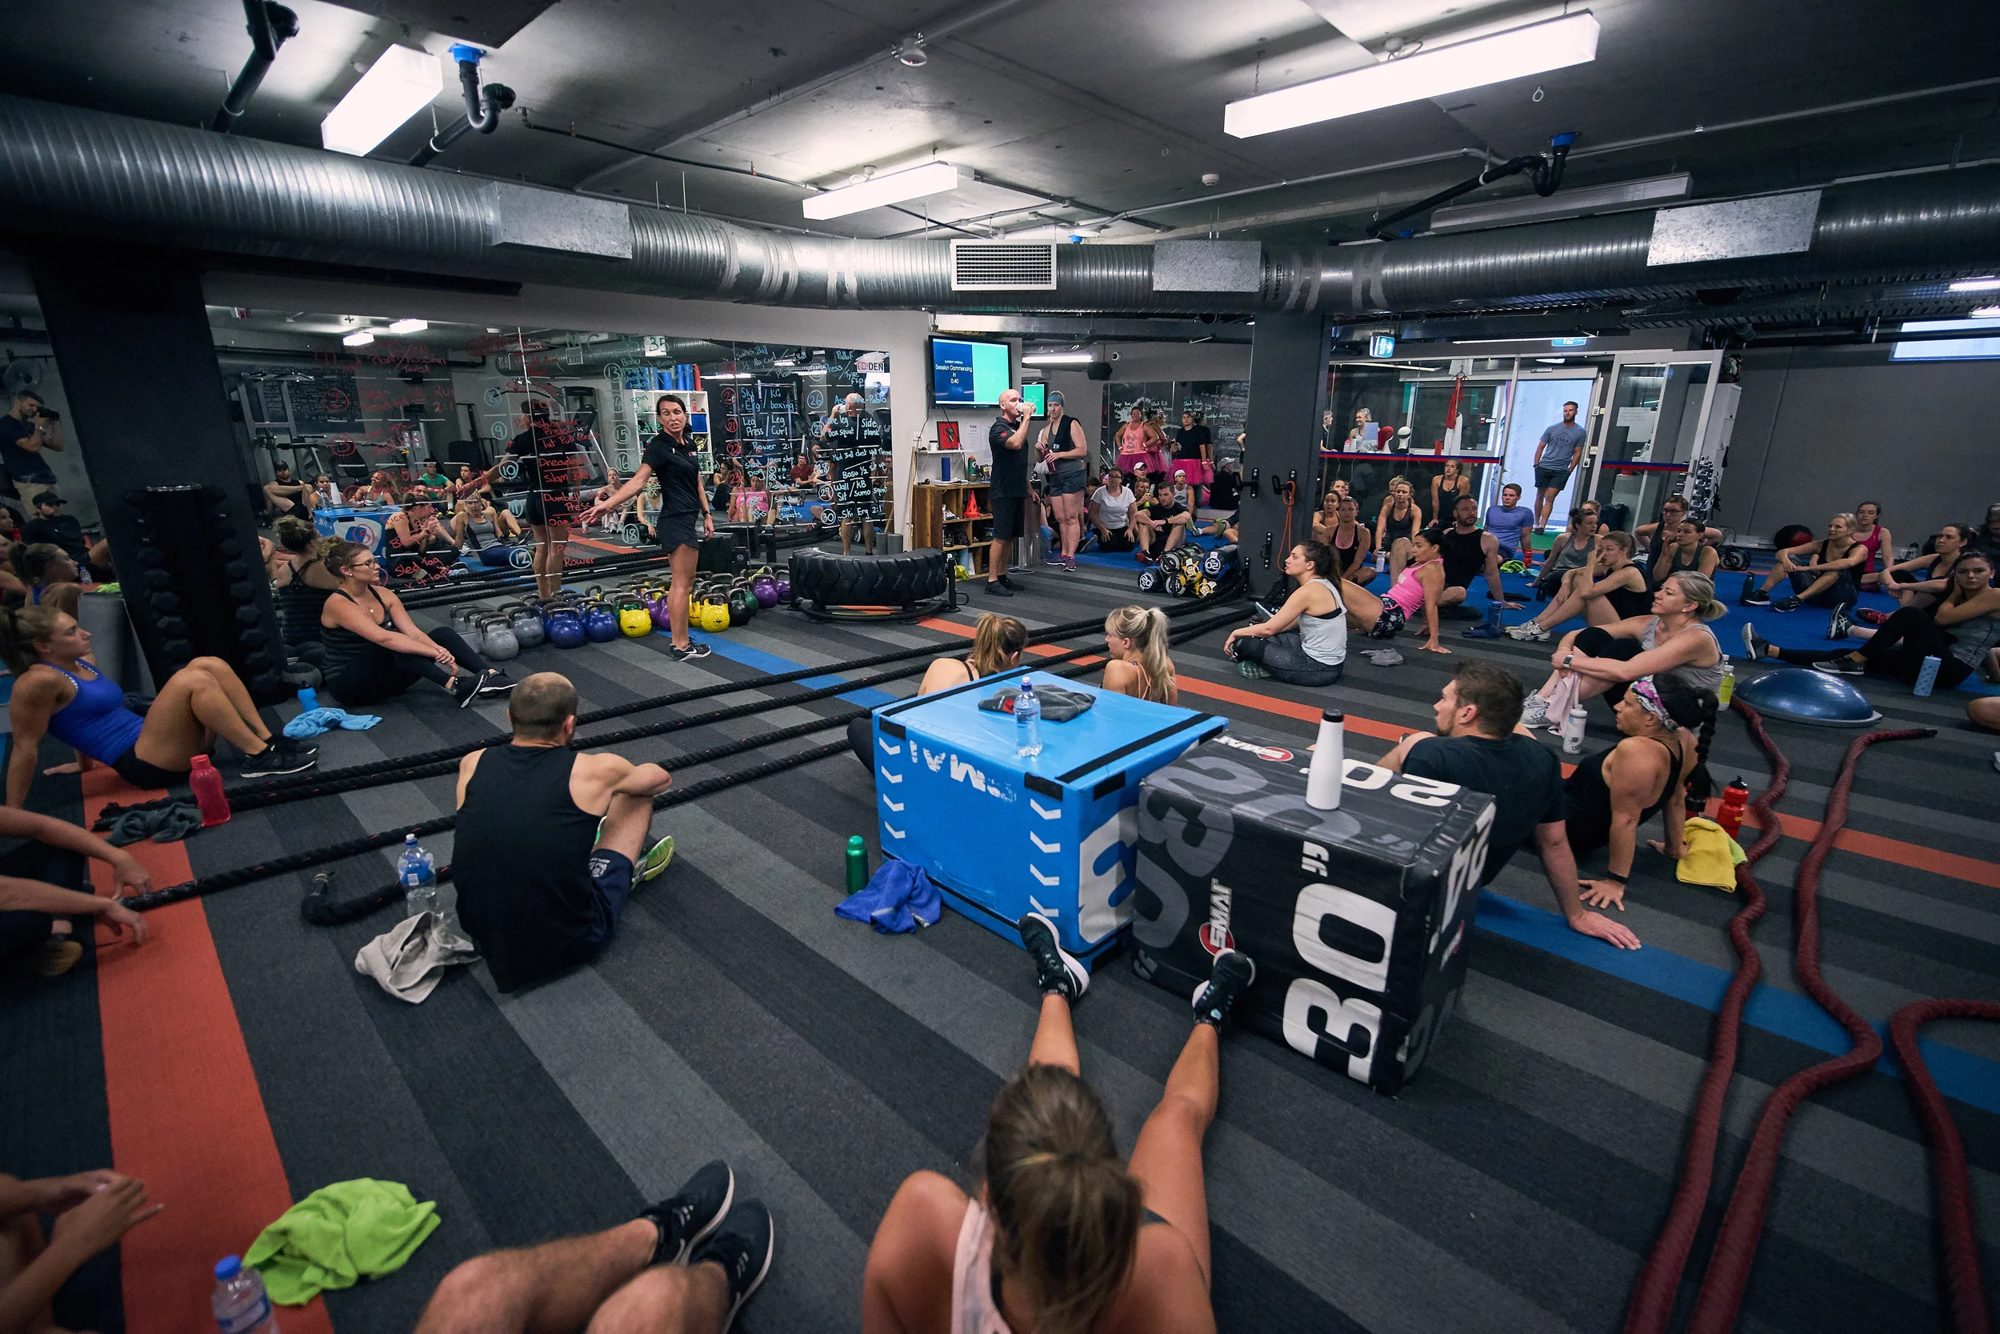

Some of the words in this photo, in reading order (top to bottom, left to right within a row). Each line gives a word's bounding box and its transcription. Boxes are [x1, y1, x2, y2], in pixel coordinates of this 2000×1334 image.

[742, 416, 757, 429] Leg
[771, 415, 786, 428] Leg
[746, 427, 765, 437] Press
[771, 426, 789, 436] Curl
[543, 472, 569, 483] Slam
[833, 482, 850, 491] Wall
[856, 480, 867, 489] KB
[836, 491, 848, 501] Sit
[857, 508, 870, 519] Erg
[548, 518, 569, 527] One
[394, 560, 420, 577] Sled
